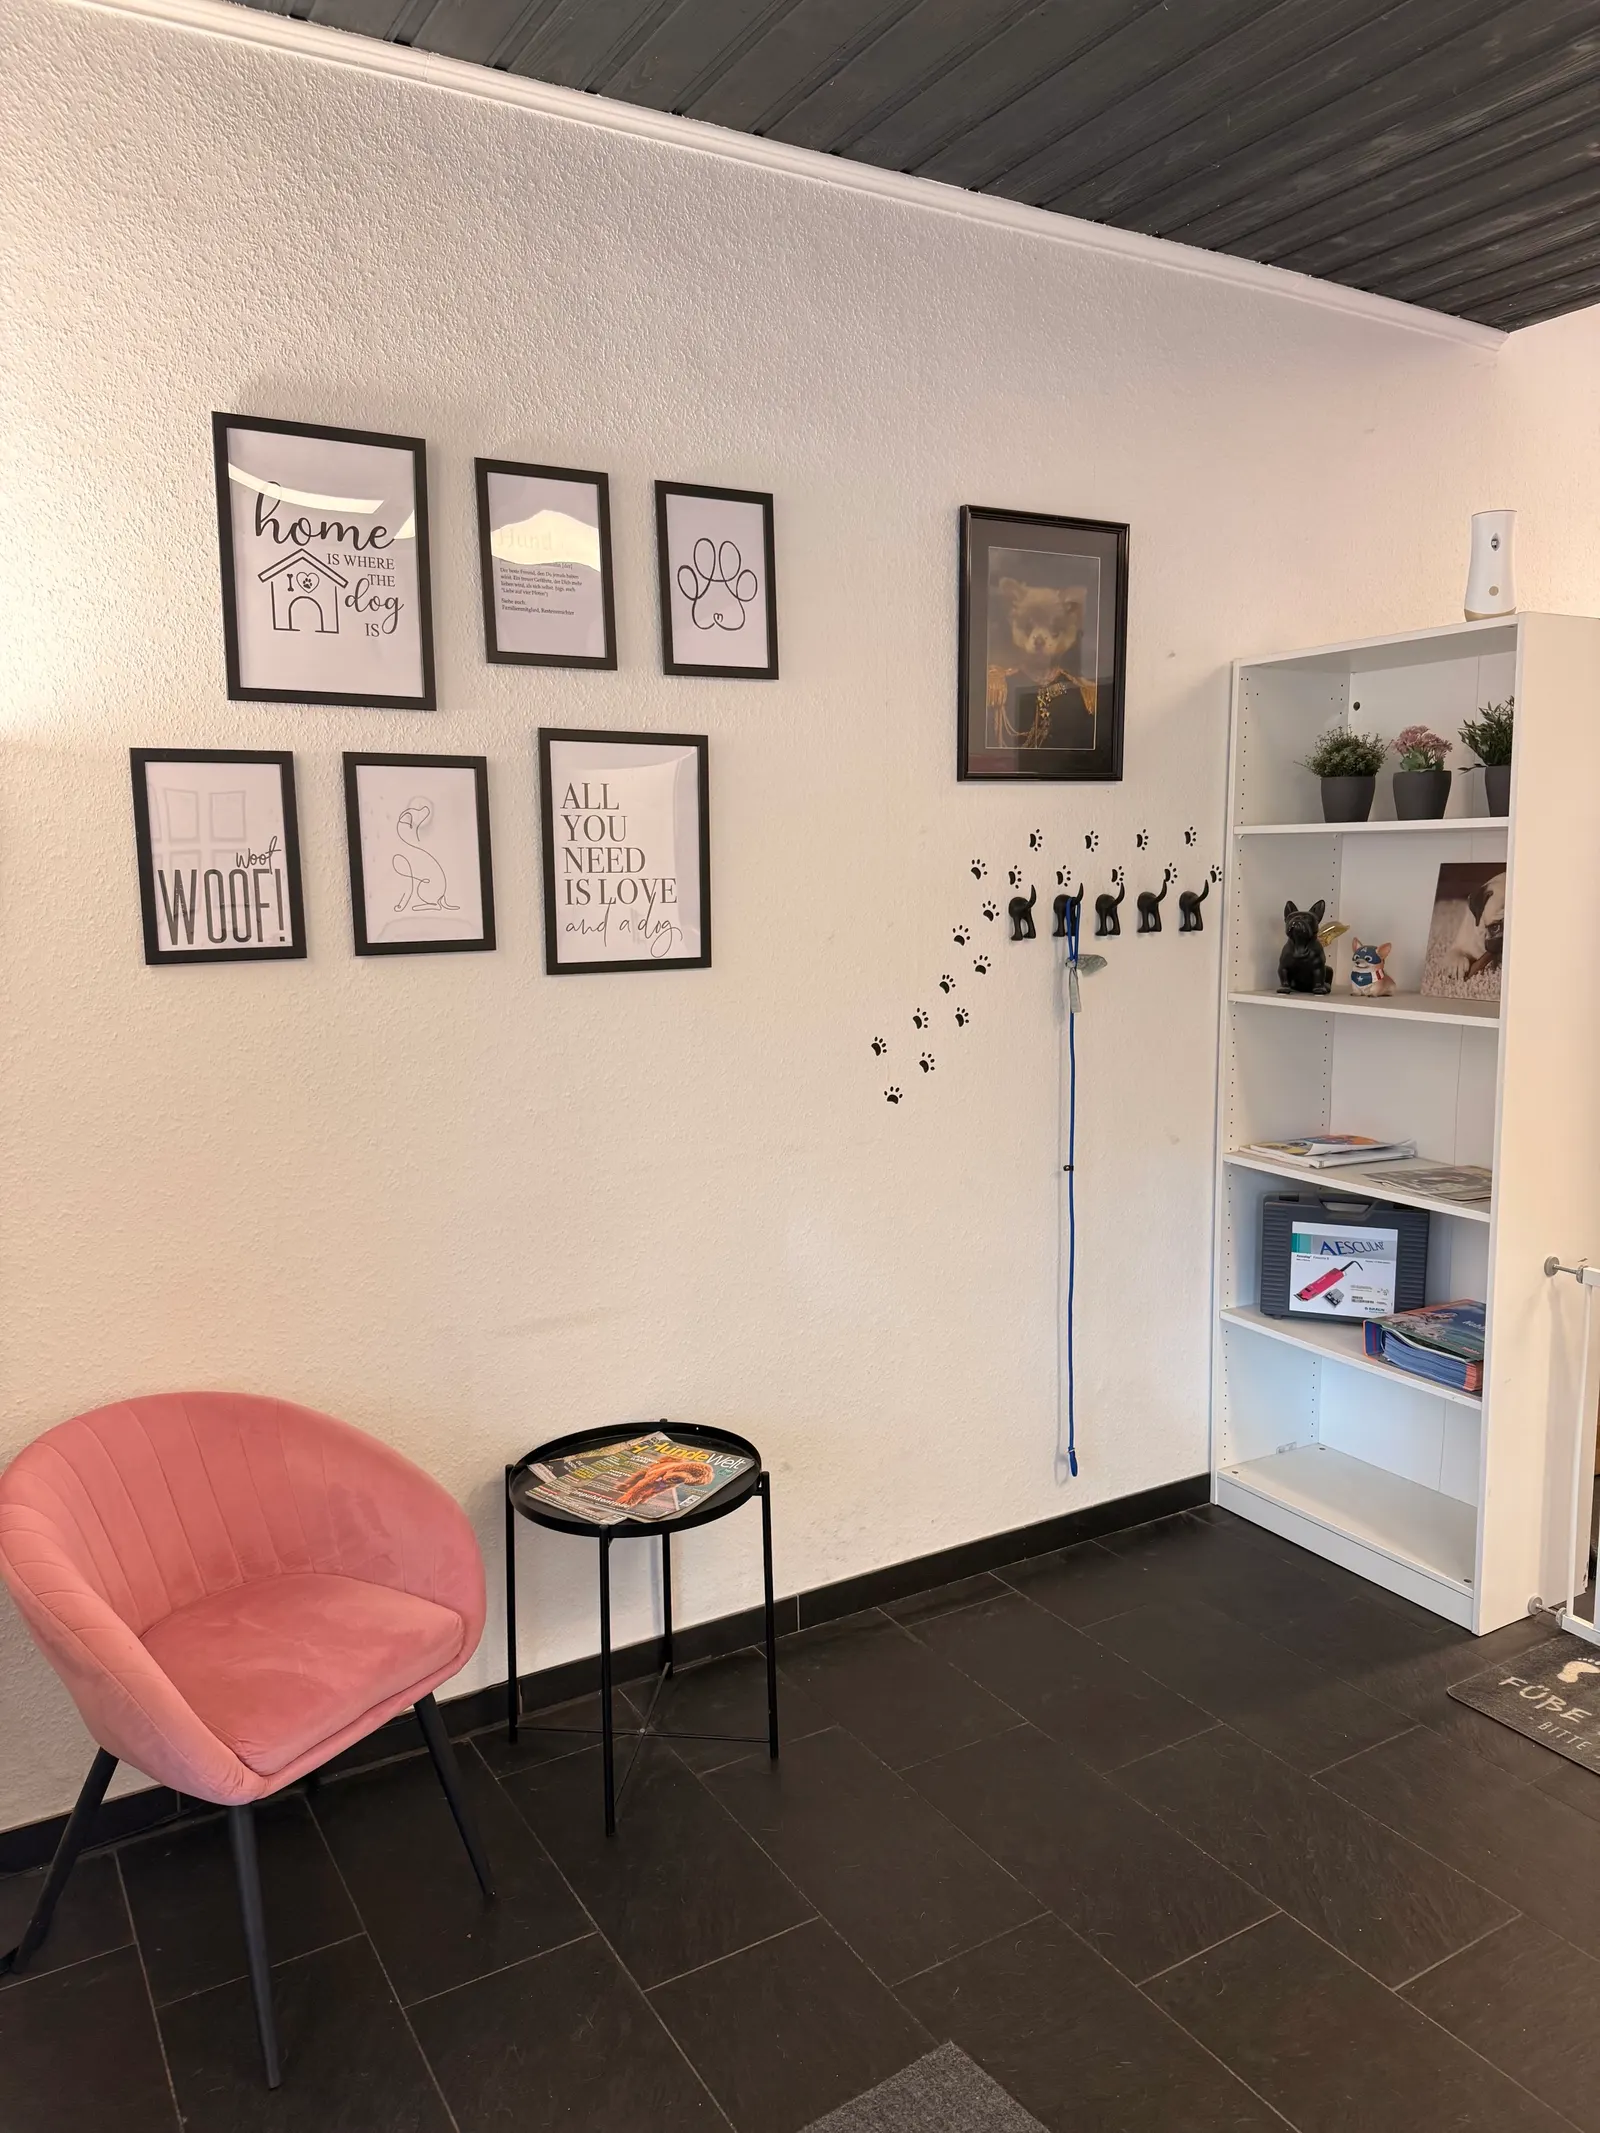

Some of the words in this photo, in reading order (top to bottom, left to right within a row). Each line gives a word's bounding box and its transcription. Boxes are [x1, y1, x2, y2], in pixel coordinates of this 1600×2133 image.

[255, 481, 396, 551] home
[327, 553, 340, 566] IS
[343, 554, 395, 570] WHERE
[367, 574, 396, 588] THE
[345, 577, 405, 635] dog
[364, 622, 380, 638] IS
[560, 782, 619, 810] ALL
[560, 814, 627, 842] YOU
[236, 835, 282, 875] woof
[562, 847, 646, 874] NEED
[565, 878, 591, 906] IS
[598, 877, 678, 905] LOVE
[157, 868, 285, 946] WOOF!
[566, 896, 612, 947] and
[619, 919, 631, 933] a
[637, 891, 683, 958] dog
[1320, 1240, 1385, 1256] AESCULAP
[1537, 1721, 1593, 1751] BITTE
